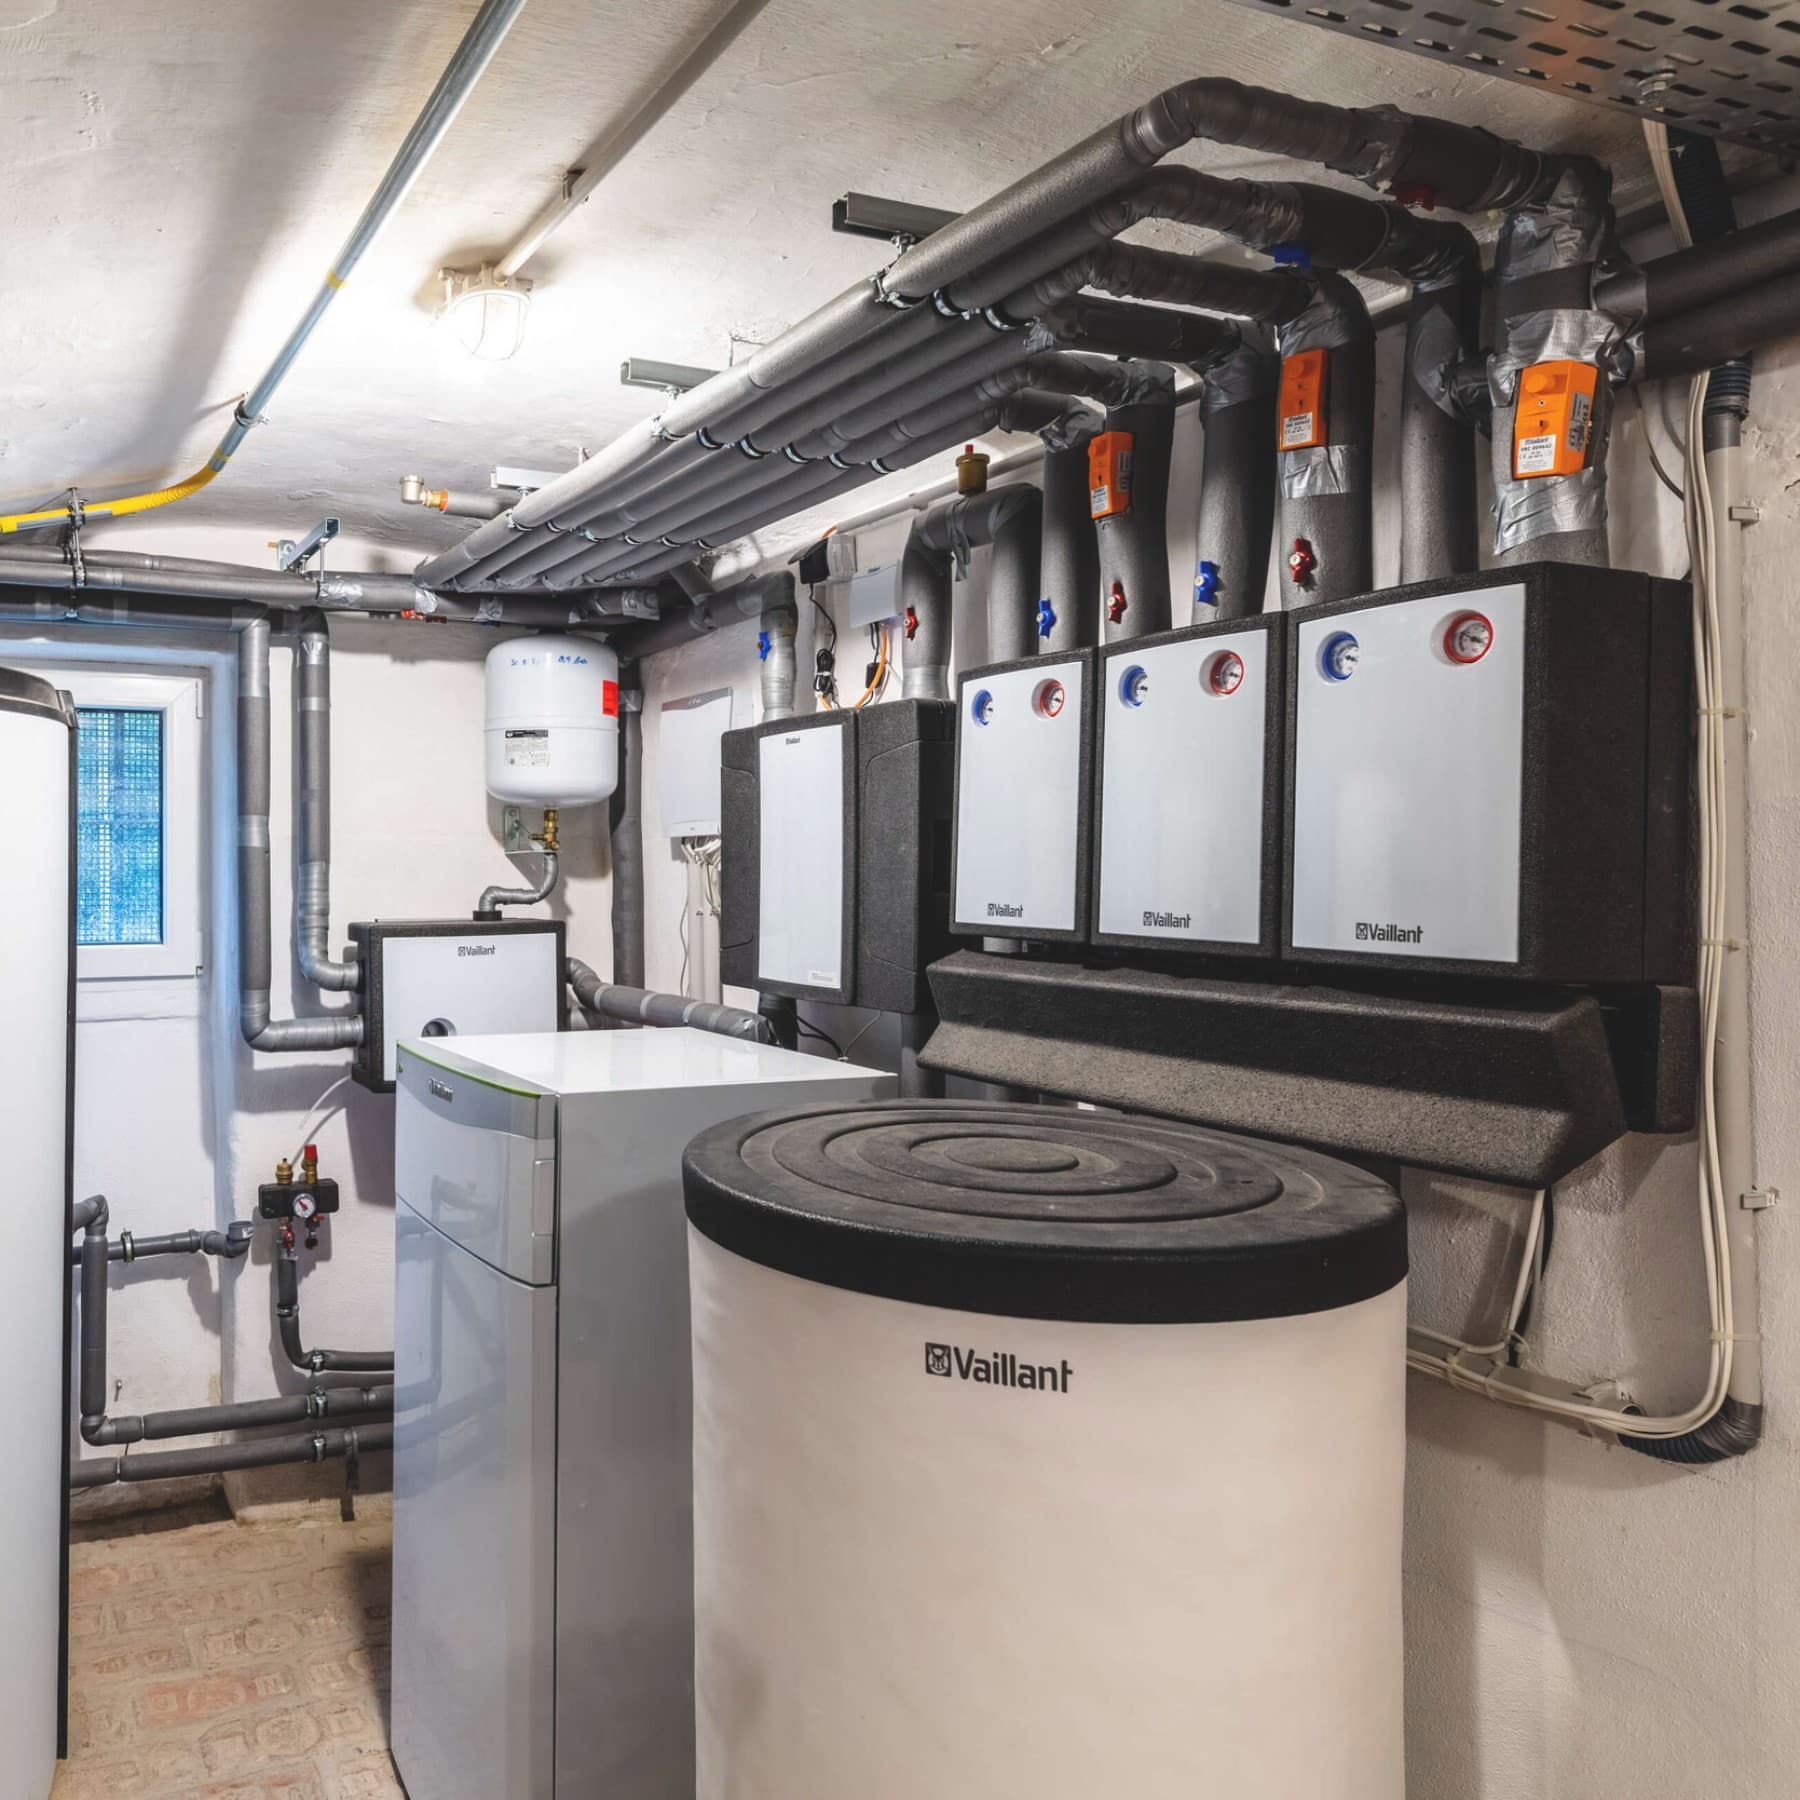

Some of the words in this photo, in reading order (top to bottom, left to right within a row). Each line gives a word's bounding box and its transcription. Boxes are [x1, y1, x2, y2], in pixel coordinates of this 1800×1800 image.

[994, 904, 1024, 918] Vaillant
[1152, 912, 1192, 929] Vaillant
[1368, 923, 1424, 944] Vaillant
[465, 944, 496, 956] Vaillant
[953, 1346, 1074, 1394] Vaillant
